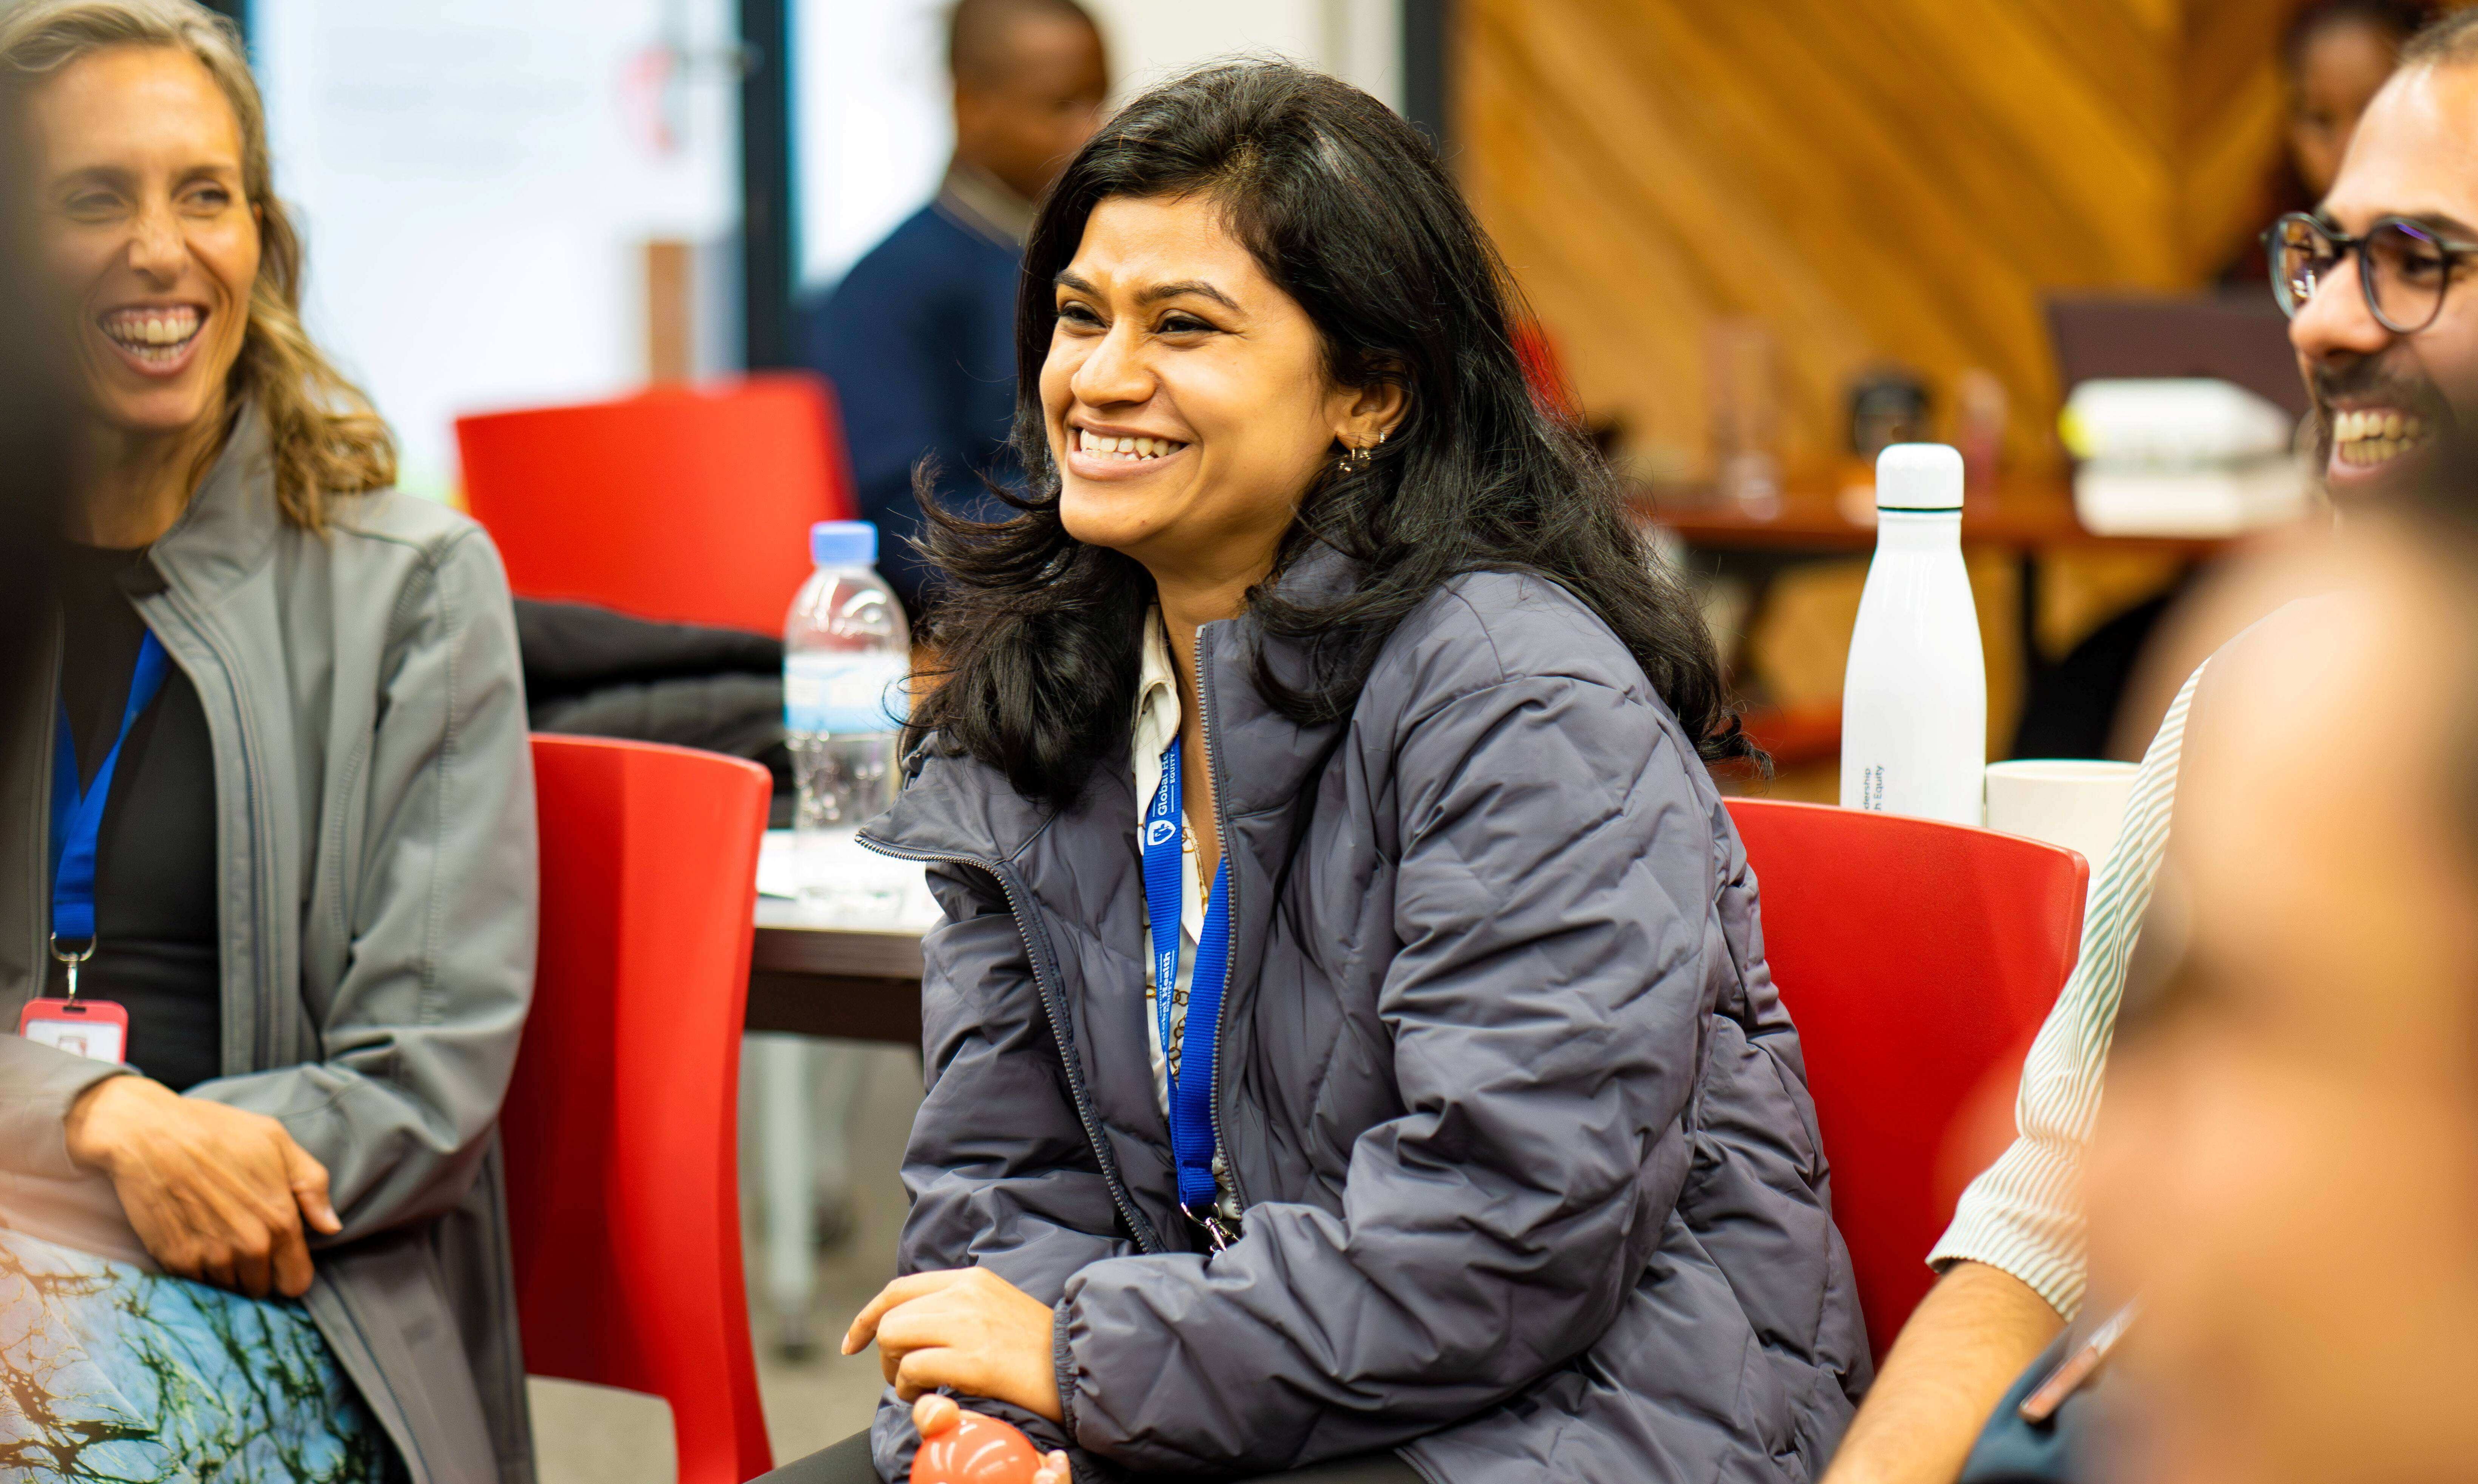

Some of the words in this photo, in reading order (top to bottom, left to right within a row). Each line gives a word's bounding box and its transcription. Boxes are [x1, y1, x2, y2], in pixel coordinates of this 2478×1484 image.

[1158, 773, 1168, 816] Global
[1863, 768, 1872, 810] dership
[1873, 765, 1885, 799] Equity
